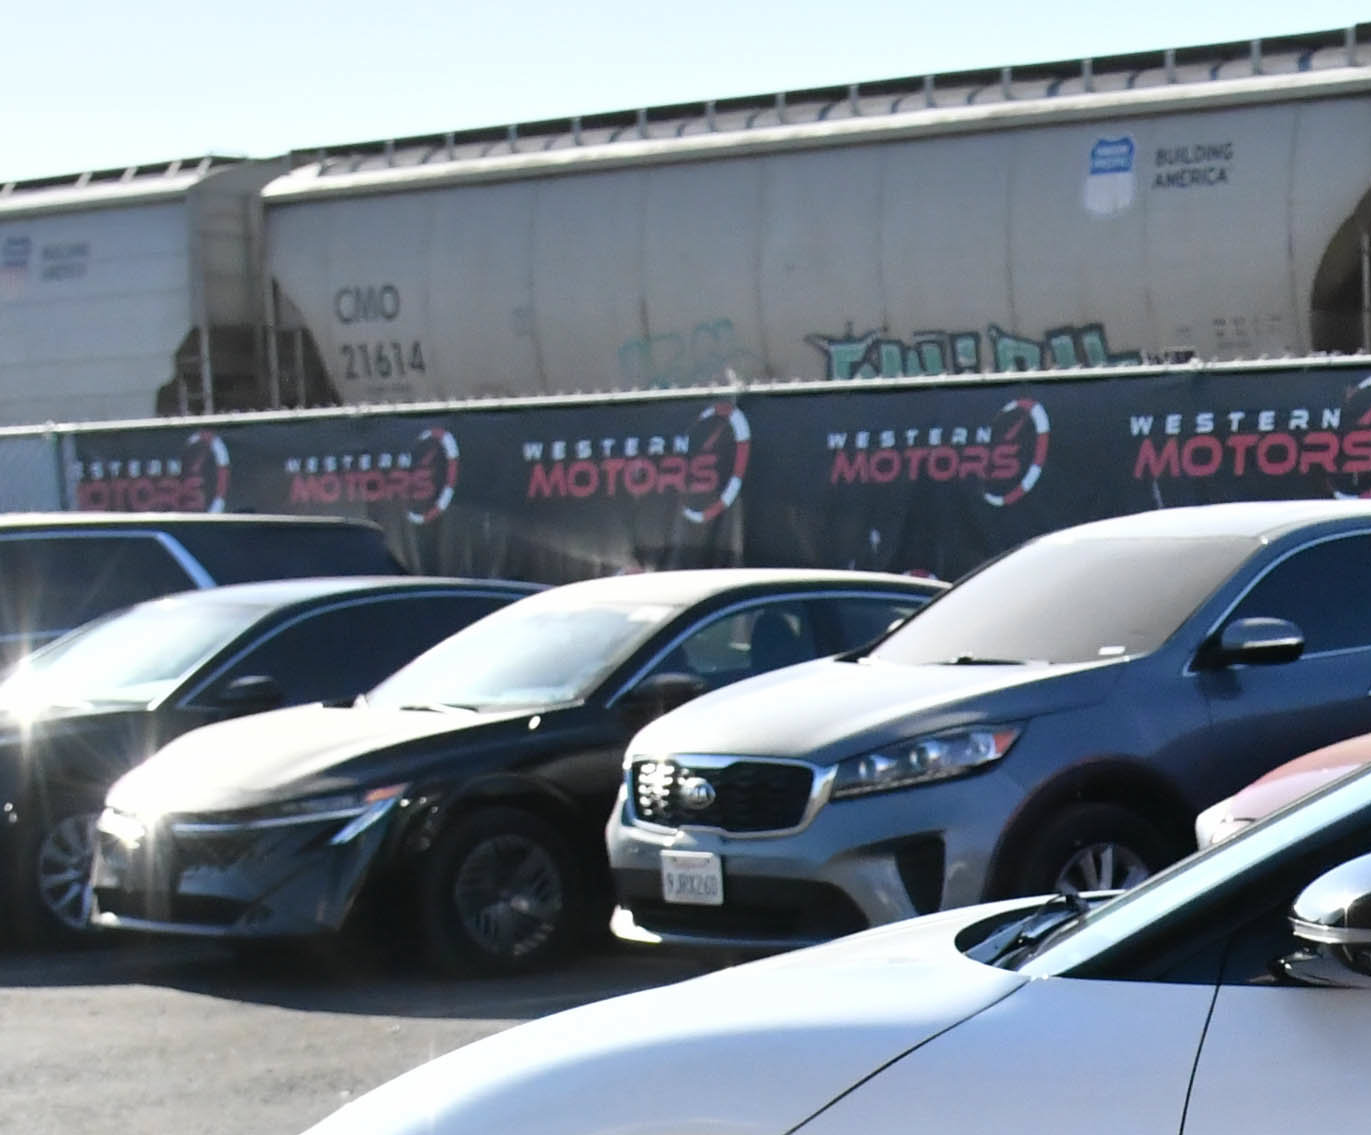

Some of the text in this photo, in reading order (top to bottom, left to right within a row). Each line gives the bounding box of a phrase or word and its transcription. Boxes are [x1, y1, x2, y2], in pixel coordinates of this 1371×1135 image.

[1154, 142, 1234, 168] BUILDING
[1152, 167, 1228, 188] AMERICA
[334, 284, 400, 325] CMO
[341, 340, 427, 379] 21614
[1130, 408, 1342, 436] WESTERN
[523, 435, 690, 461] WESTERN
[827, 426, 992, 449] WESTERN
[284, 452, 412, 474] WESTERN
[527, 453, 719, 498] MOTORS
[831, 444, 1021, 484] MOTORS
[290, 468, 434, 503] MOTORS
